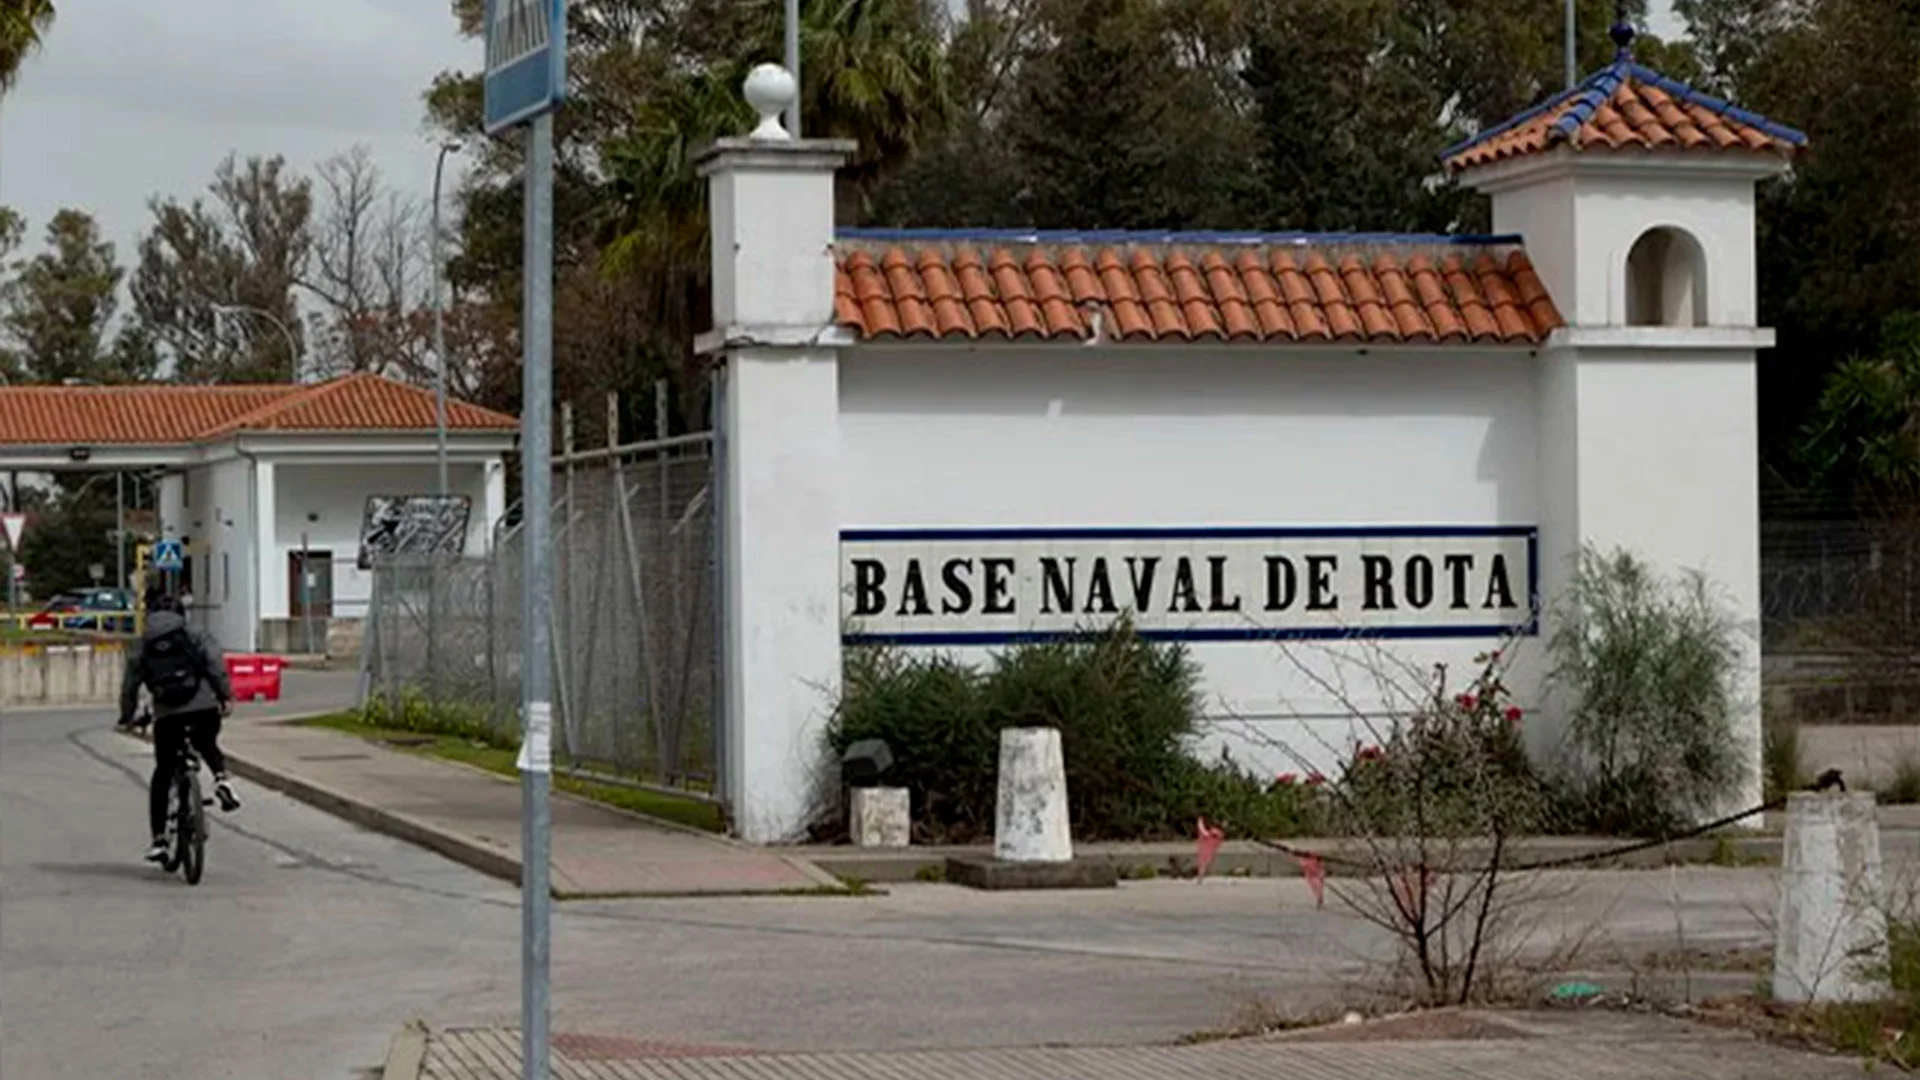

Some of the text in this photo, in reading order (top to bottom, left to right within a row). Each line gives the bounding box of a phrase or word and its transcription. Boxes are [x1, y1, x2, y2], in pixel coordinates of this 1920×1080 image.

[851, 553, 1518, 616] BASE NAVAL DE ROTA
